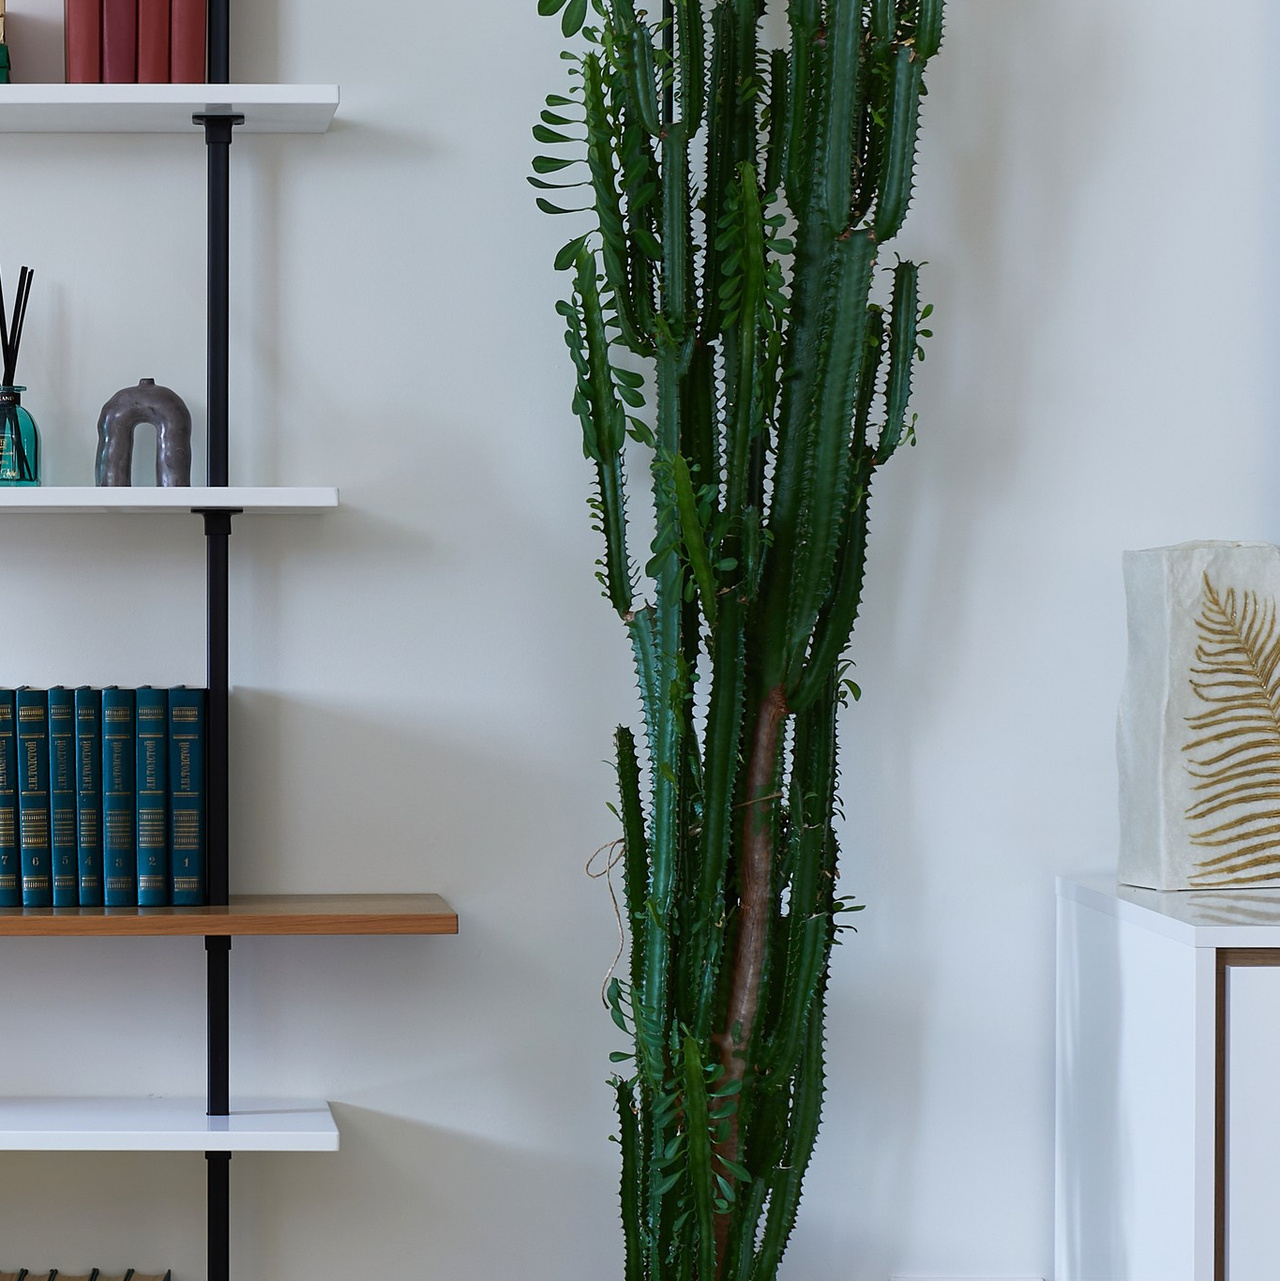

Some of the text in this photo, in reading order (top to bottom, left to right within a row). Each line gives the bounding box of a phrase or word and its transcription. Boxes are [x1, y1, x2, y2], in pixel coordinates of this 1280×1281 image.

[1, 856, 8, 865] 7
[33, 857, 39, 866] 6
[62, 856, 69, 865] 5
[85, 856, 92, 866] 4
[116, 858, 123, 867] 3
[148, 857, 156, 866] 2
[183, 858, 189, 866] 1
